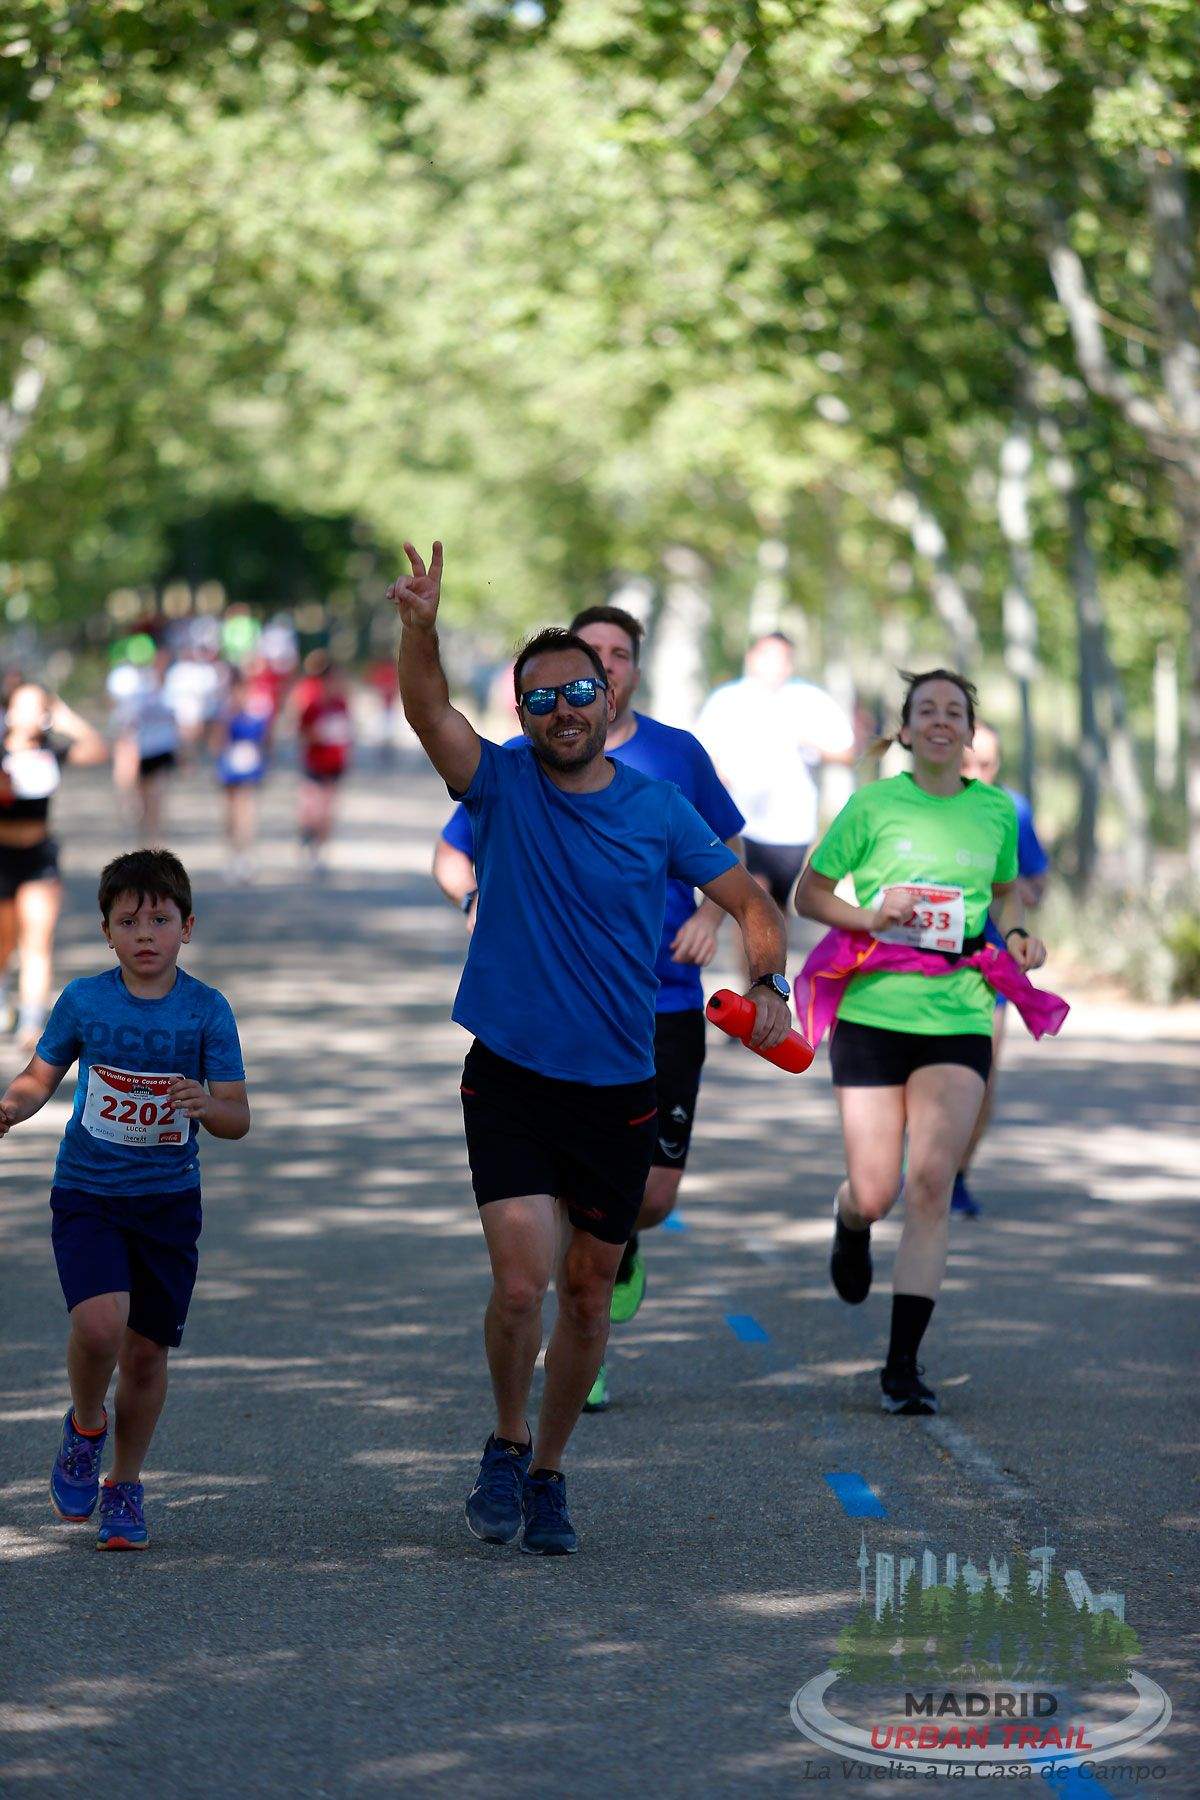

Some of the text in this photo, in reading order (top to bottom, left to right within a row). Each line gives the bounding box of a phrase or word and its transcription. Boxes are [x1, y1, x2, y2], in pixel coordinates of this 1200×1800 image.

[895, 908, 950, 931] 233
[106, 1071, 126, 1082] Vuelta
[100, 1095, 176, 1126] 2202
[126, 1125, 147, 1133] LUCCA
